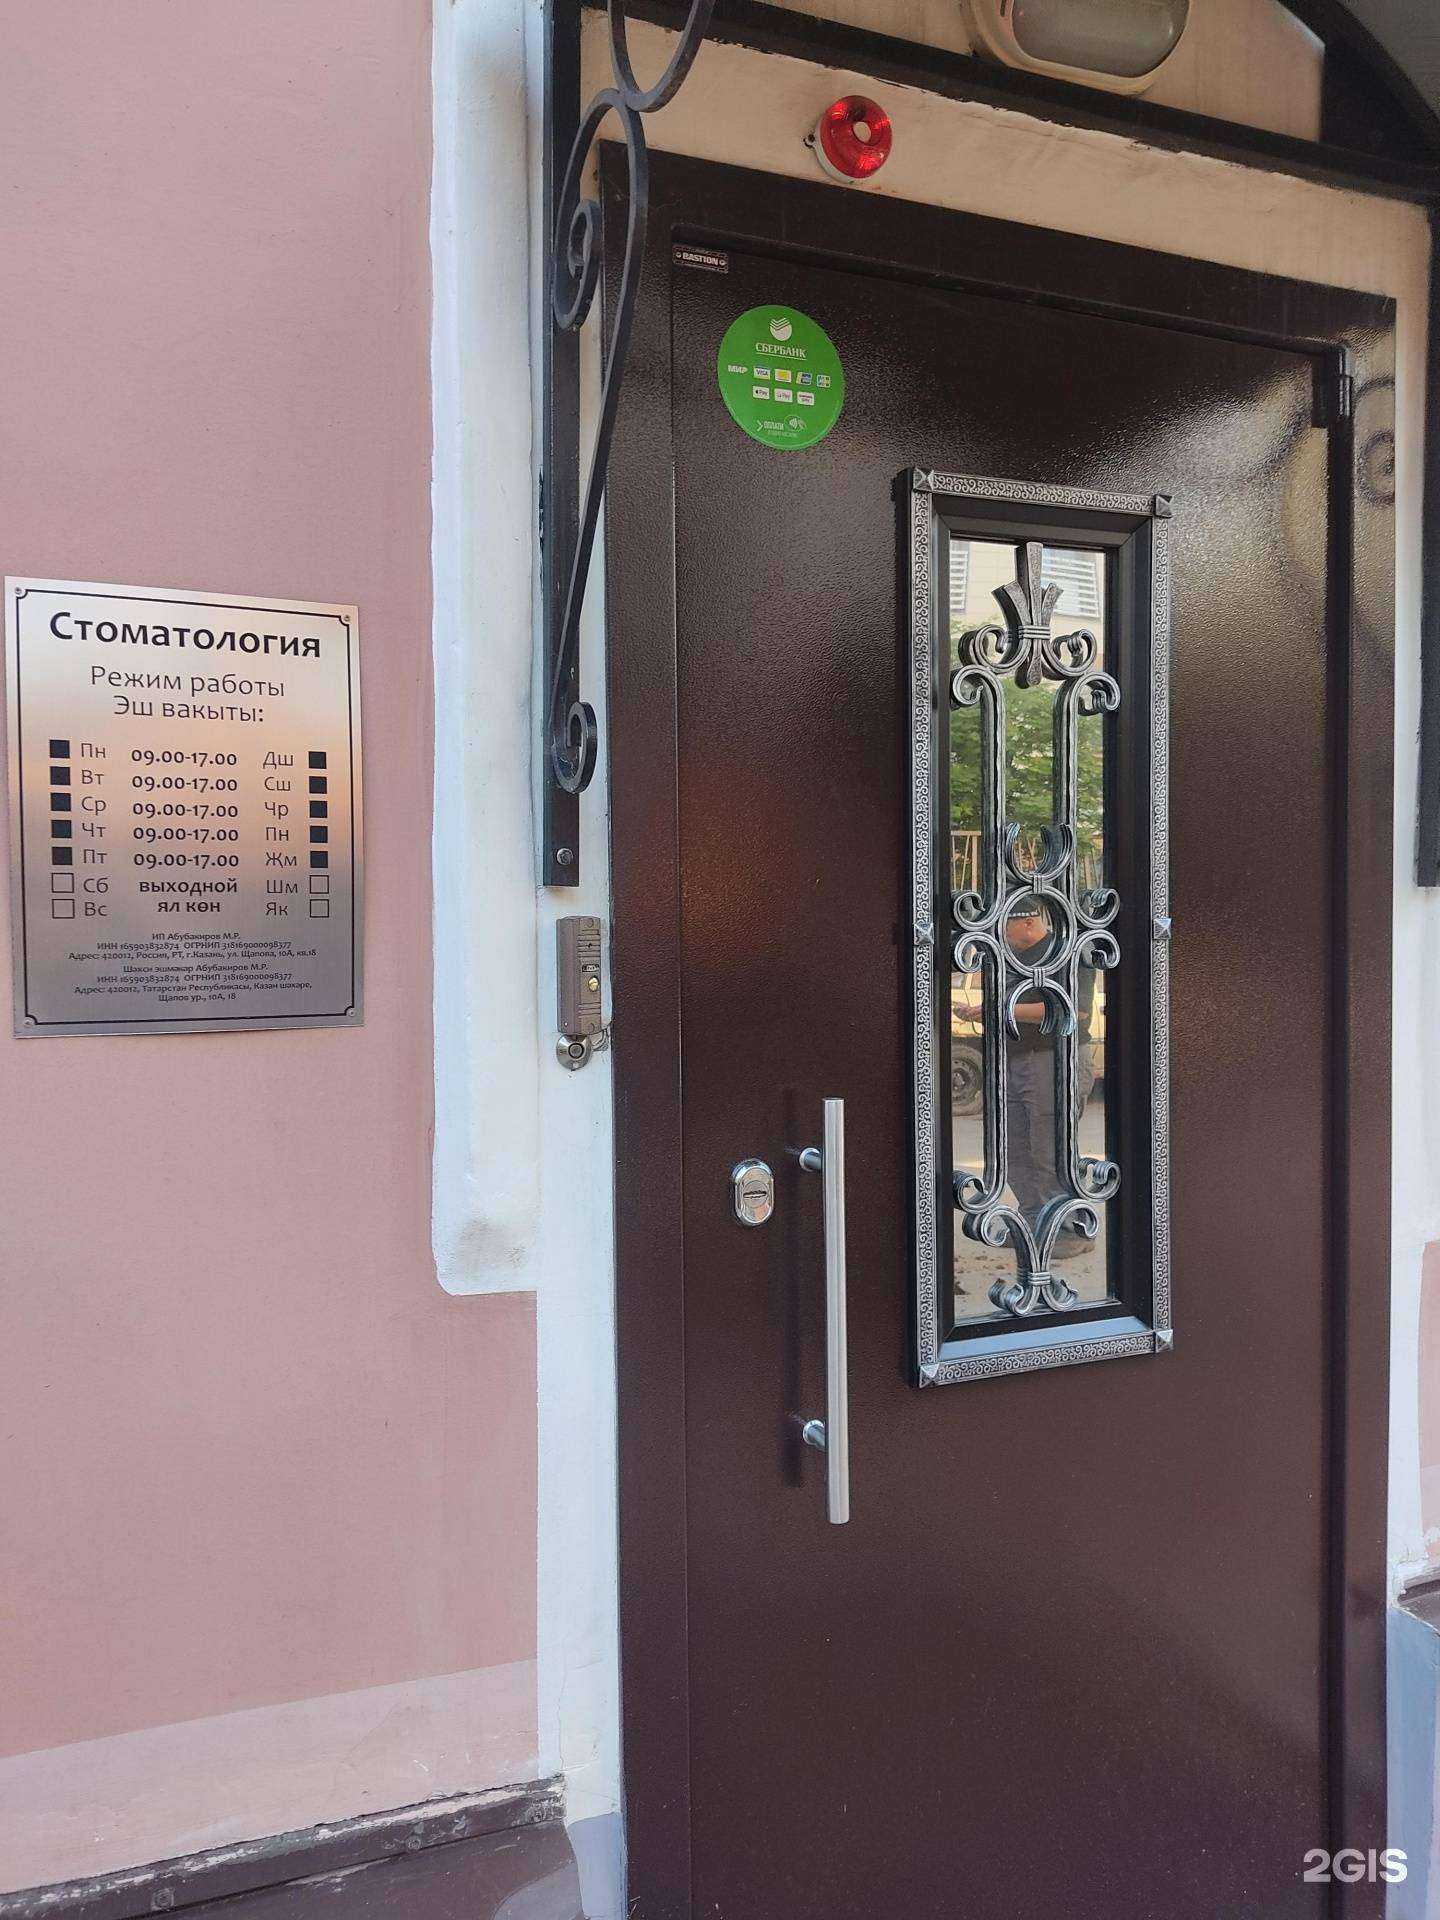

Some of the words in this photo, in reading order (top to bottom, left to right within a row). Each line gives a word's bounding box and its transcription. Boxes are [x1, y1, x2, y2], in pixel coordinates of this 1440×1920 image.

[682, 252, 720, 267] BASTION
[755, 342, 807, 358] СБЕРБАНК
[49, 611, 321, 658] Стоматология
[91, 665, 182, 691] Режим
[190, 673, 285, 698] работы
[113, 695, 153, 717] Эш
[162, 702, 264, 723] вакыты:
[81, 743, 106, 759] Пн
[131, 749, 238, 766] 09.00-17.00
[263, 751, 294, 768] Дш
[81, 769, 104, 785] Вт
[131, 775, 238, 792] 09.00-17.00
[264, 776, 291, 792] Сш
[81, 796, 107, 815] Ср
[132, 802, 239, 818] 09.00-17.00
[264, 801, 289, 820] Чр
[82, 823, 107, 839] Чт
[132, 827, 239, 844] 09.00-17.00
[265, 827, 289, 841] Пн
[83, 849, 107, 864] Пт
[133, 852, 239, 869] 09.00-17.00
[83, 877, 109, 894] Сб
[139, 877, 238, 896] выходной
[266, 880, 298, 894] Шм
[84, 901, 108, 917] Вс
[157, 900, 180, 914] ял
[186, 899, 221, 914] көн
[265, 901, 289, 917] Як
[97, 942, 118, 950] ИНН
[184, 941, 220, 949] ОГРНИП
[152, 933, 165, 941] ИП
[167, 932, 221, 942] Абубакиров
[223, 932, 241, 940] М.Р.
[136, 952, 169, 960] Россия,
[172, 951, 184, 959] РТ,
[241, 950, 277, 959] Щапова,
[195, 963, 249, 974] Абубакиров
[250, 963, 269, 971] М.Р.
[97, 975, 118, 983] ИНН
[184, 974, 221, 982] ОГРНИП
[142, 984, 187, 993] Татарстан
[188, 983, 251, 993] Республикасы,
[253, 982, 277, 990] Казан
[158, 994, 190, 1002] Щапов
